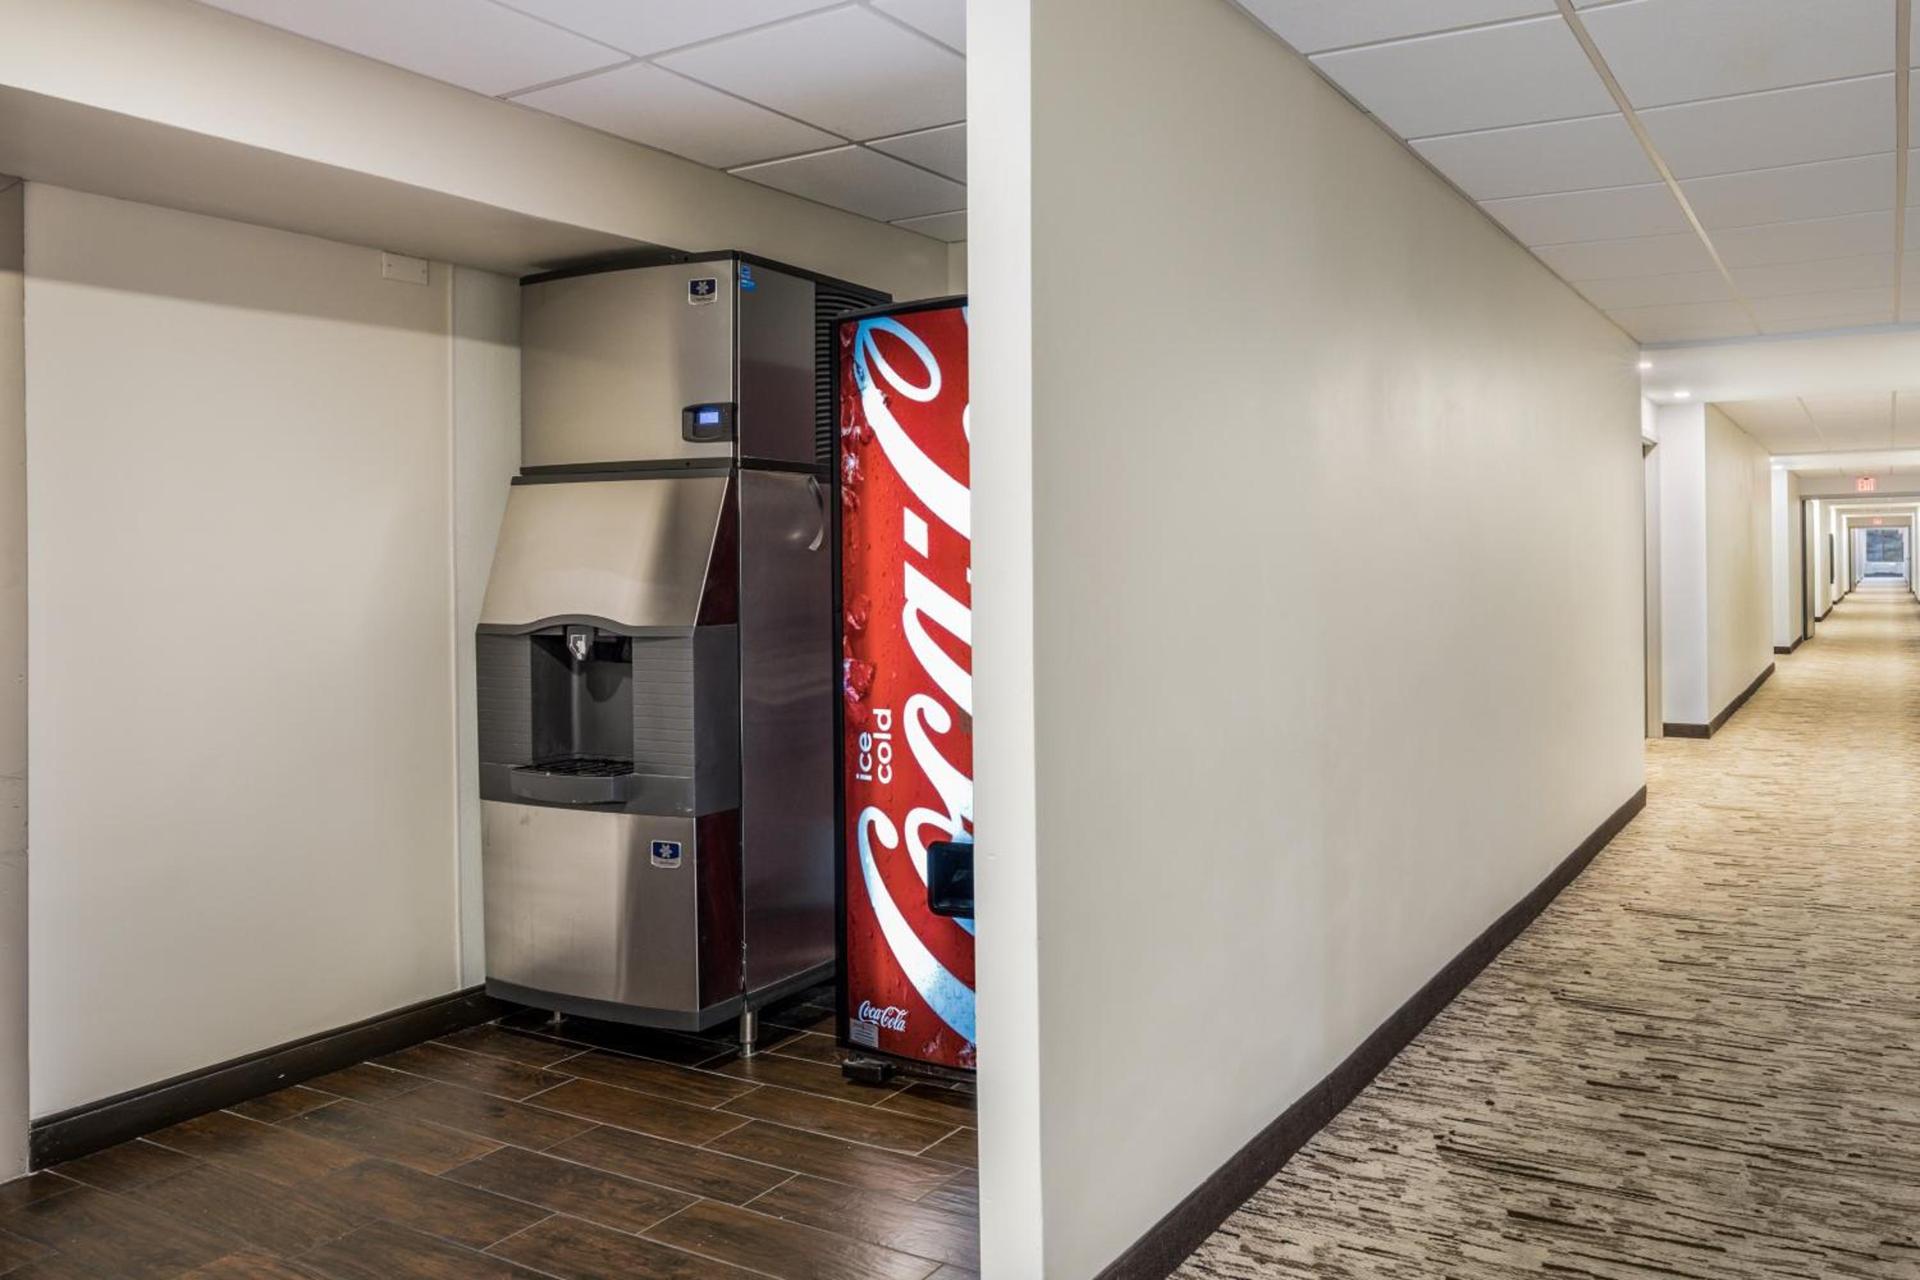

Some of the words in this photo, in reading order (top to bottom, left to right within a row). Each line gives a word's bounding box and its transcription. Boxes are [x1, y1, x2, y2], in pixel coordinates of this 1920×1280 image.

[856, 732, 872, 781] ice
[873, 708, 892, 784] cold
[858, 1000, 909, 1033] Coca-Cola
